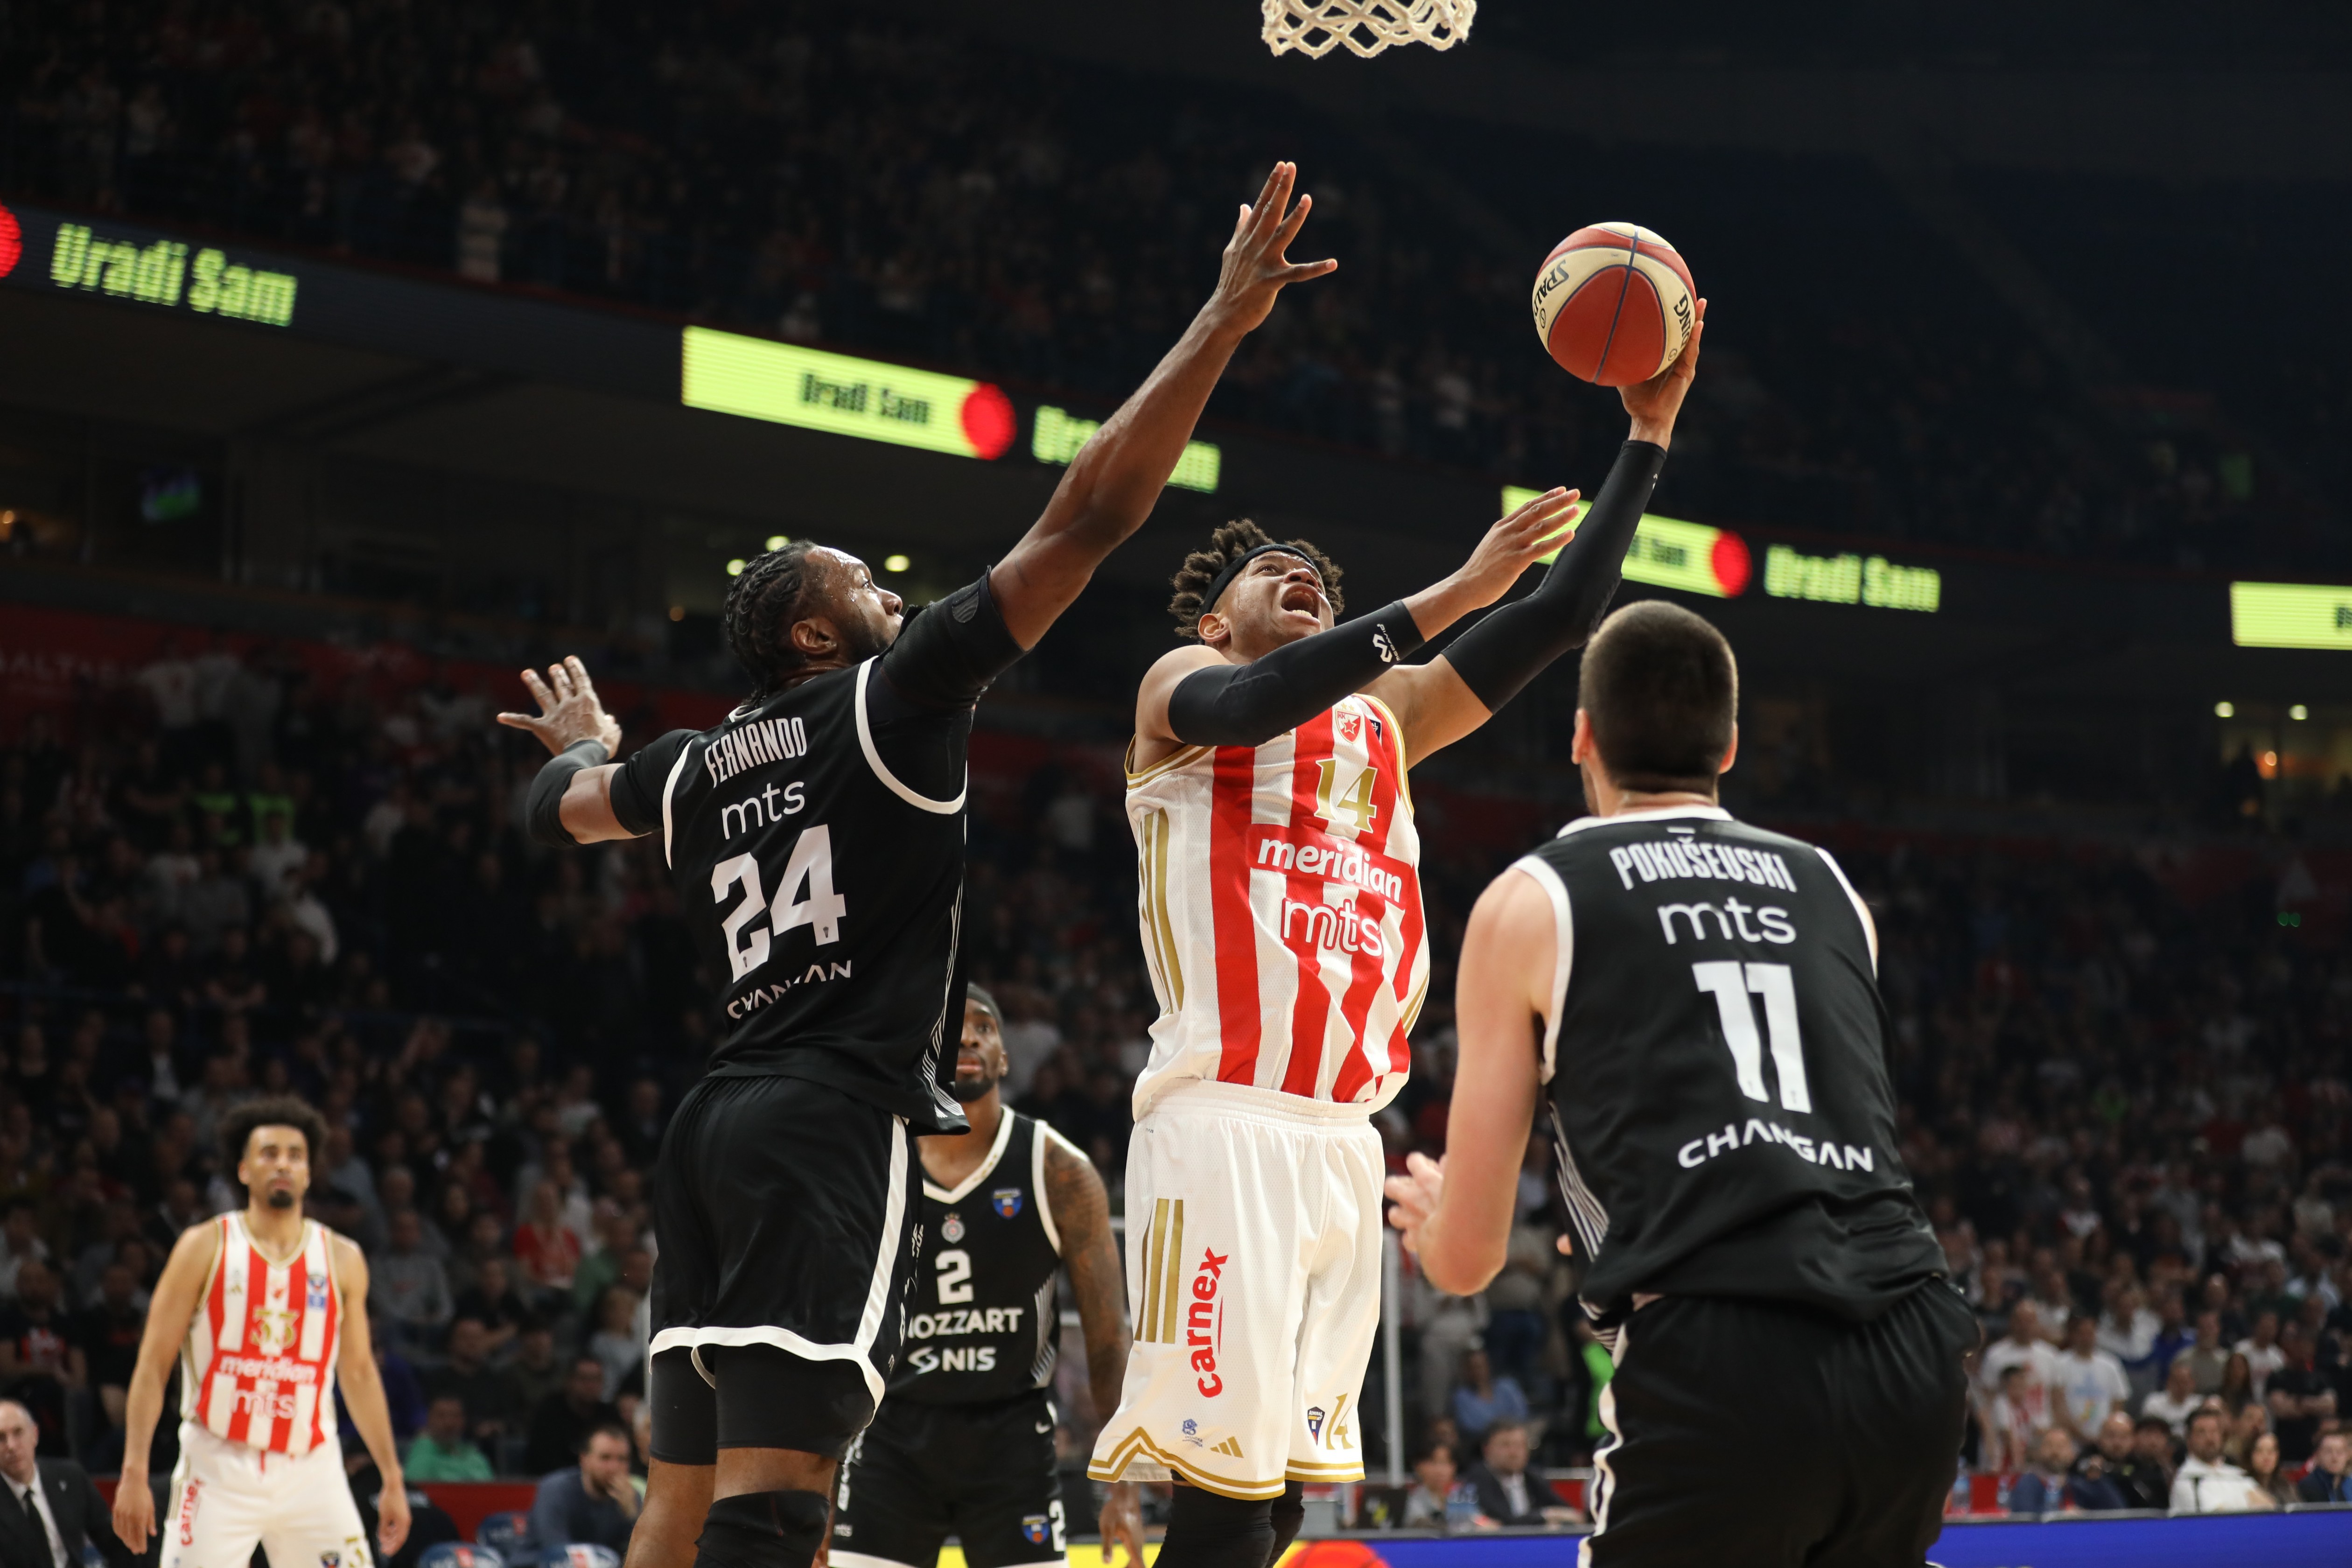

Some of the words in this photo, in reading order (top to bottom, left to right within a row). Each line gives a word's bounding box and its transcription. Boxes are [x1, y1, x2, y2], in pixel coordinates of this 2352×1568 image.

[49, 222, 189, 307] Uradi
[188, 247, 299, 327] Sam
[704, 716, 807, 789] FERNANDO
[721, 781, 805, 840] mts
[1314, 758, 1378, 833] 14
[1258, 839, 1402, 903] meridian
[711, 824, 847, 984] 24
[1283, 898, 1384, 957] mts
[1657, 896, 1797, 945] mts
[727, 959, 852, 1019] CHANAN
[1692, 960, 1812, 1114] 11
[1678, 1119, 1873, 1172] CHANGAN
[935, 1249, 974, 1305] 2
[249, 1307, 300, 1350] 33
[1187, 1246, 1228, 1398] carnex
[220, 1356, 317, 1385] meridian
[942, 1346, 997, 1372] NIS
[231, 1389, 297, 1420] mts
